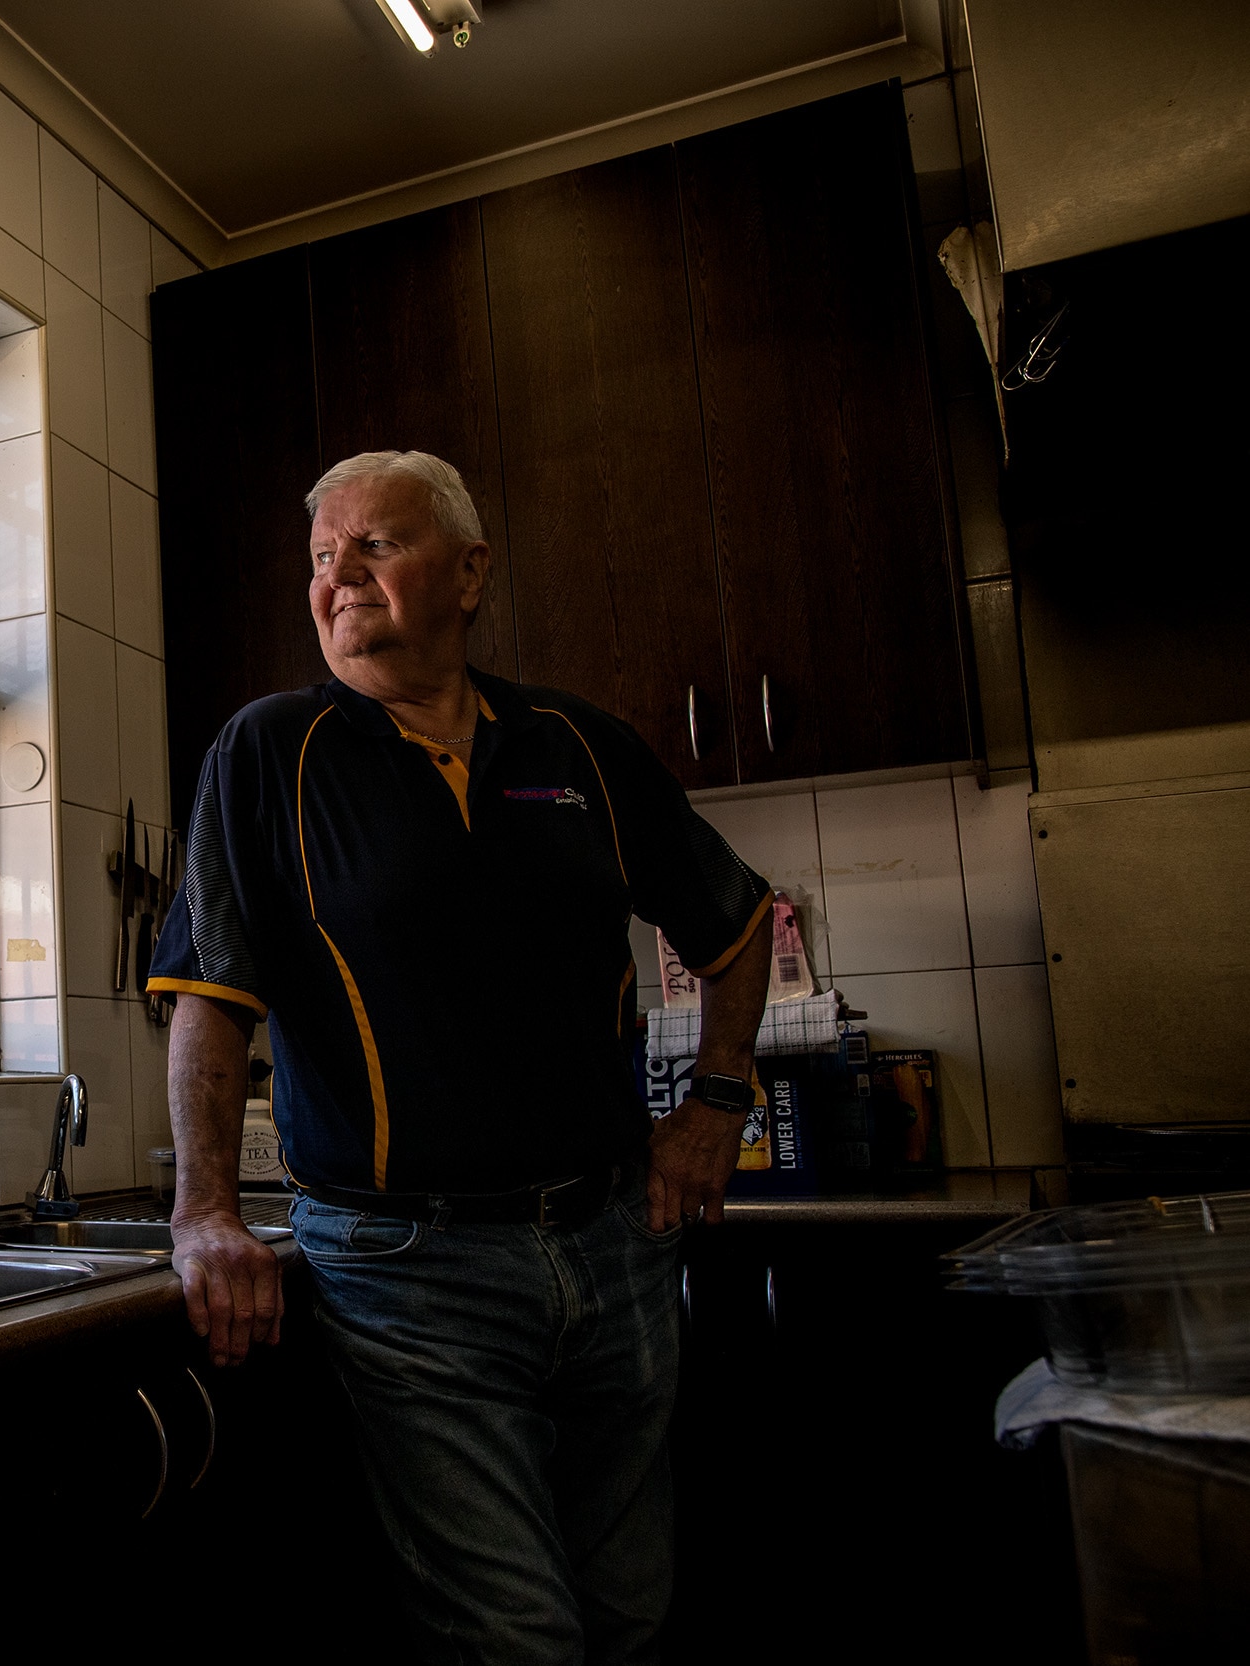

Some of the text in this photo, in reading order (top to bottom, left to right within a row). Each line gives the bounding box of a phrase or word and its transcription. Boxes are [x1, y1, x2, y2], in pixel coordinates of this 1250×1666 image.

[687, 978, 696, 993] 500
[885, 1053, 923, 1061] HERCULES
[645, 1058, 671, 1120] RLTO
[746, 1112, 764, 1121] RY
[774, 1080, 796, 1169] LOWER CARB
[246, 1148, 269, 1159] TEA
